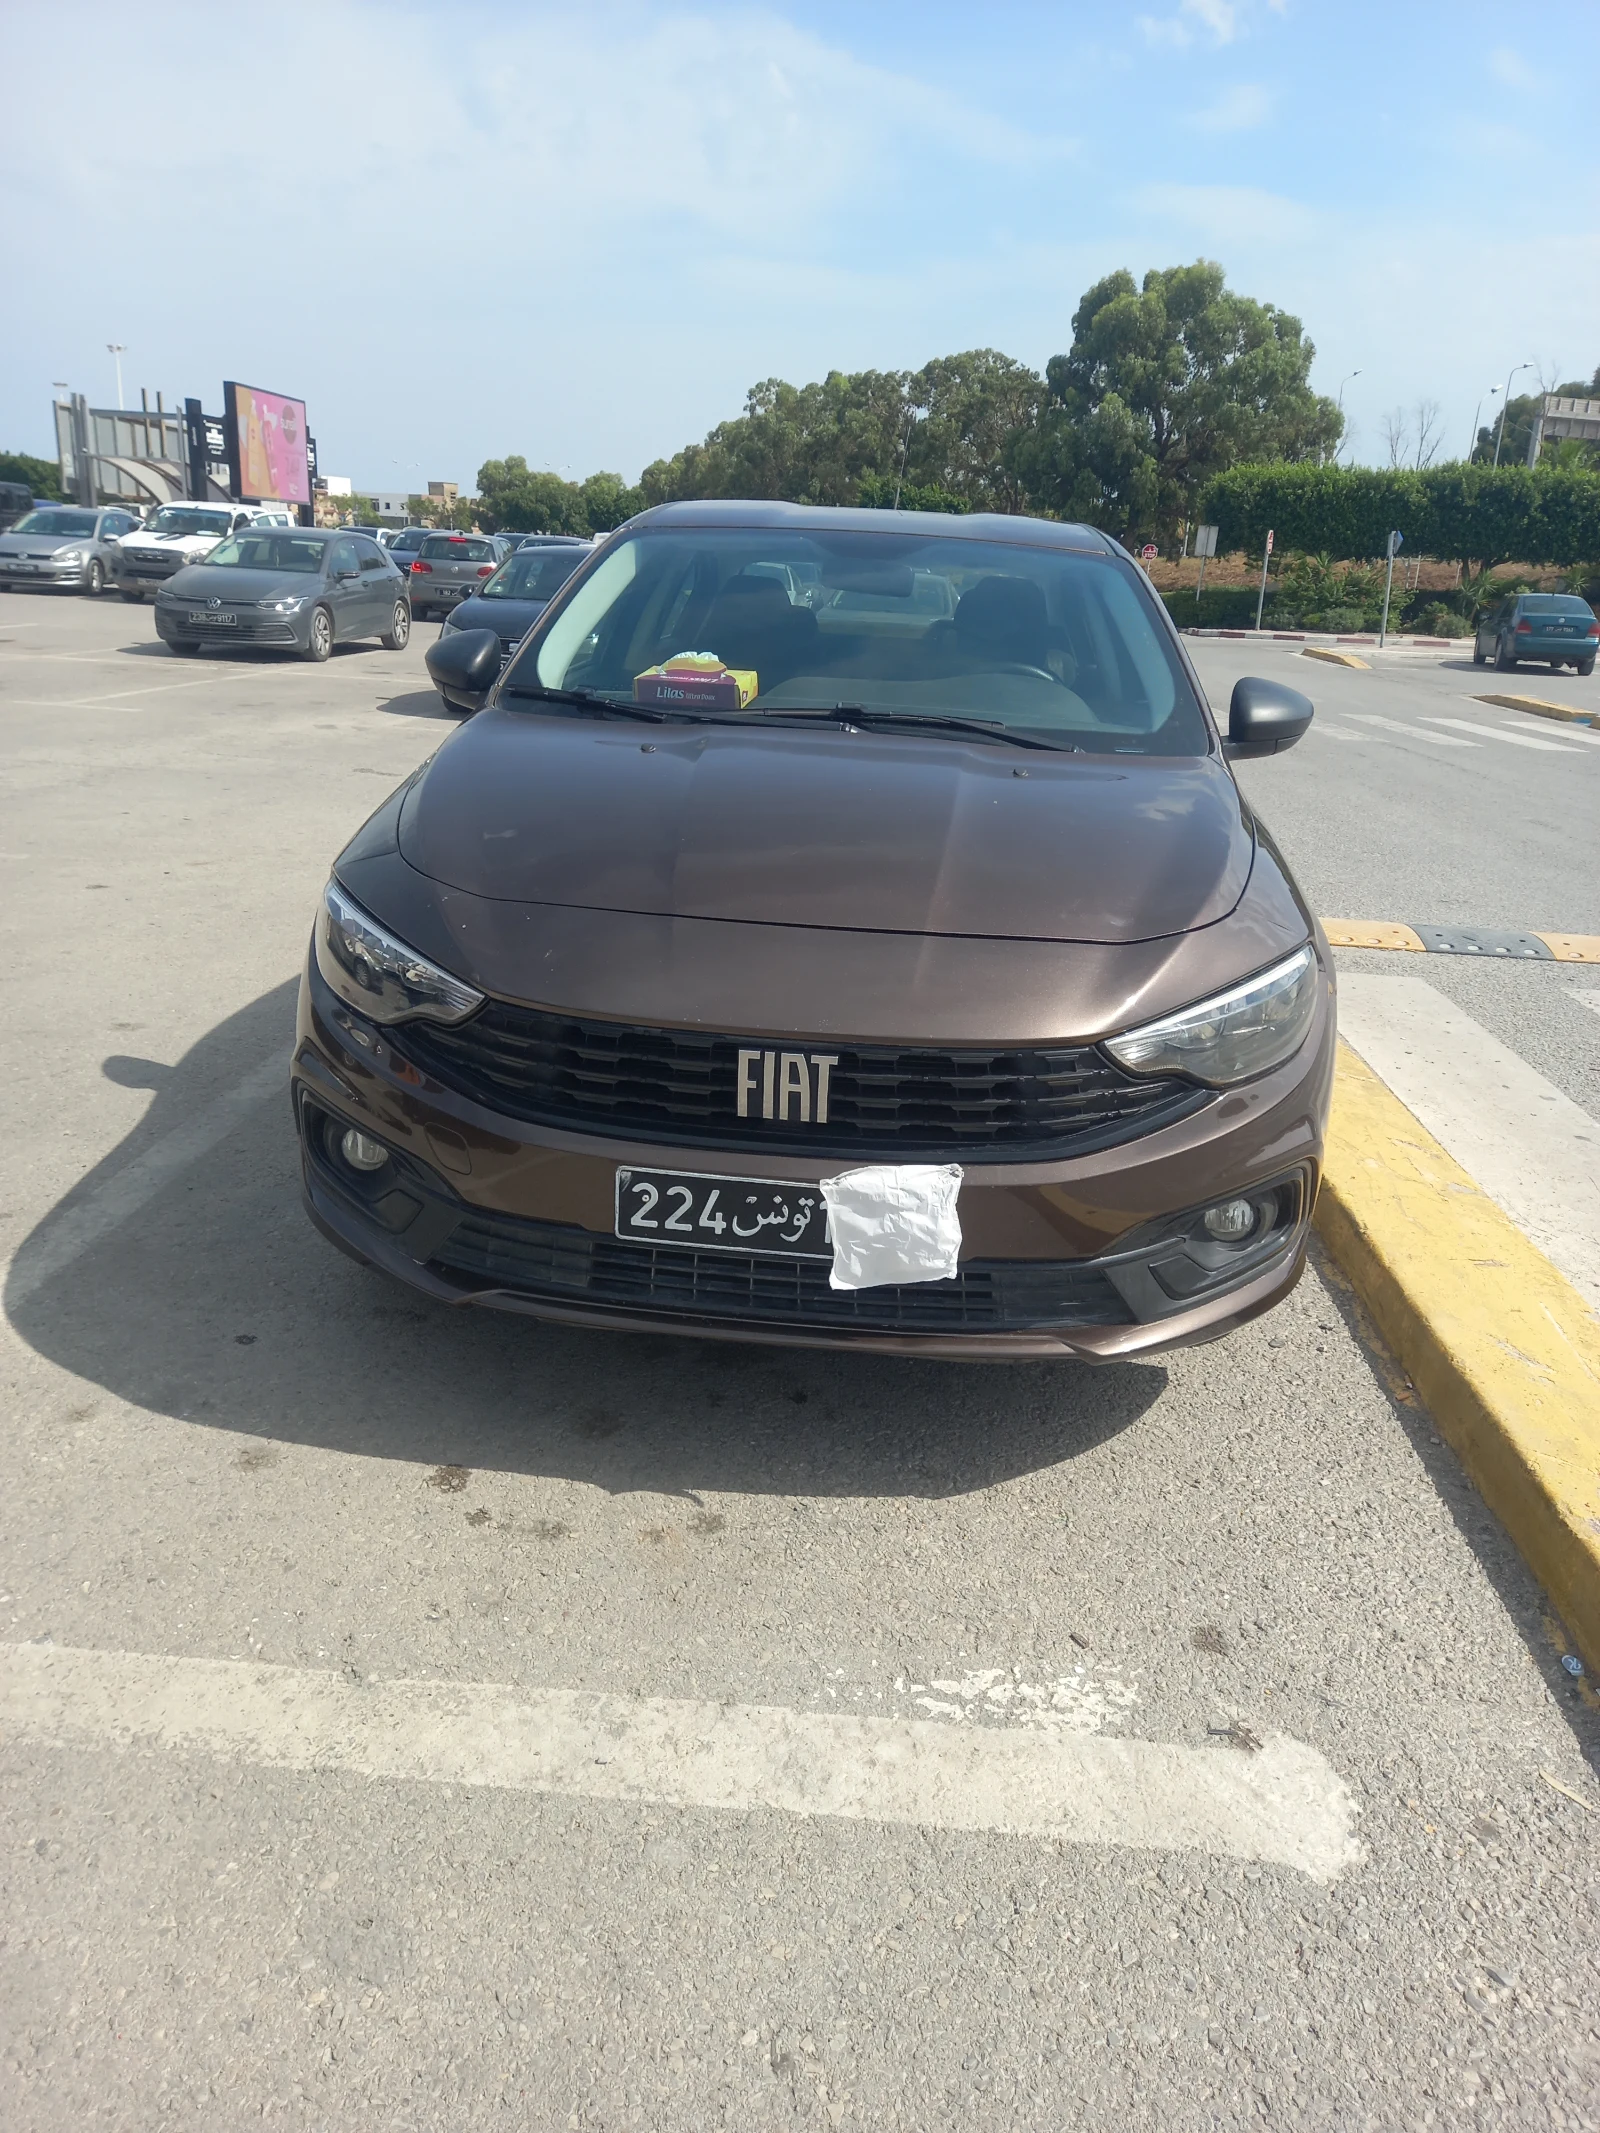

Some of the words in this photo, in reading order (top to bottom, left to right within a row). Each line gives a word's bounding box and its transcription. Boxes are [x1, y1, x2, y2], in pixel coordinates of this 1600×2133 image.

[656, 686, 685, 699] Lilas
[737, 1049, 839, 1124] FIAT
[630, 1182, 727, 1236] 224
[732, 1195, 815, 1242] تونس
